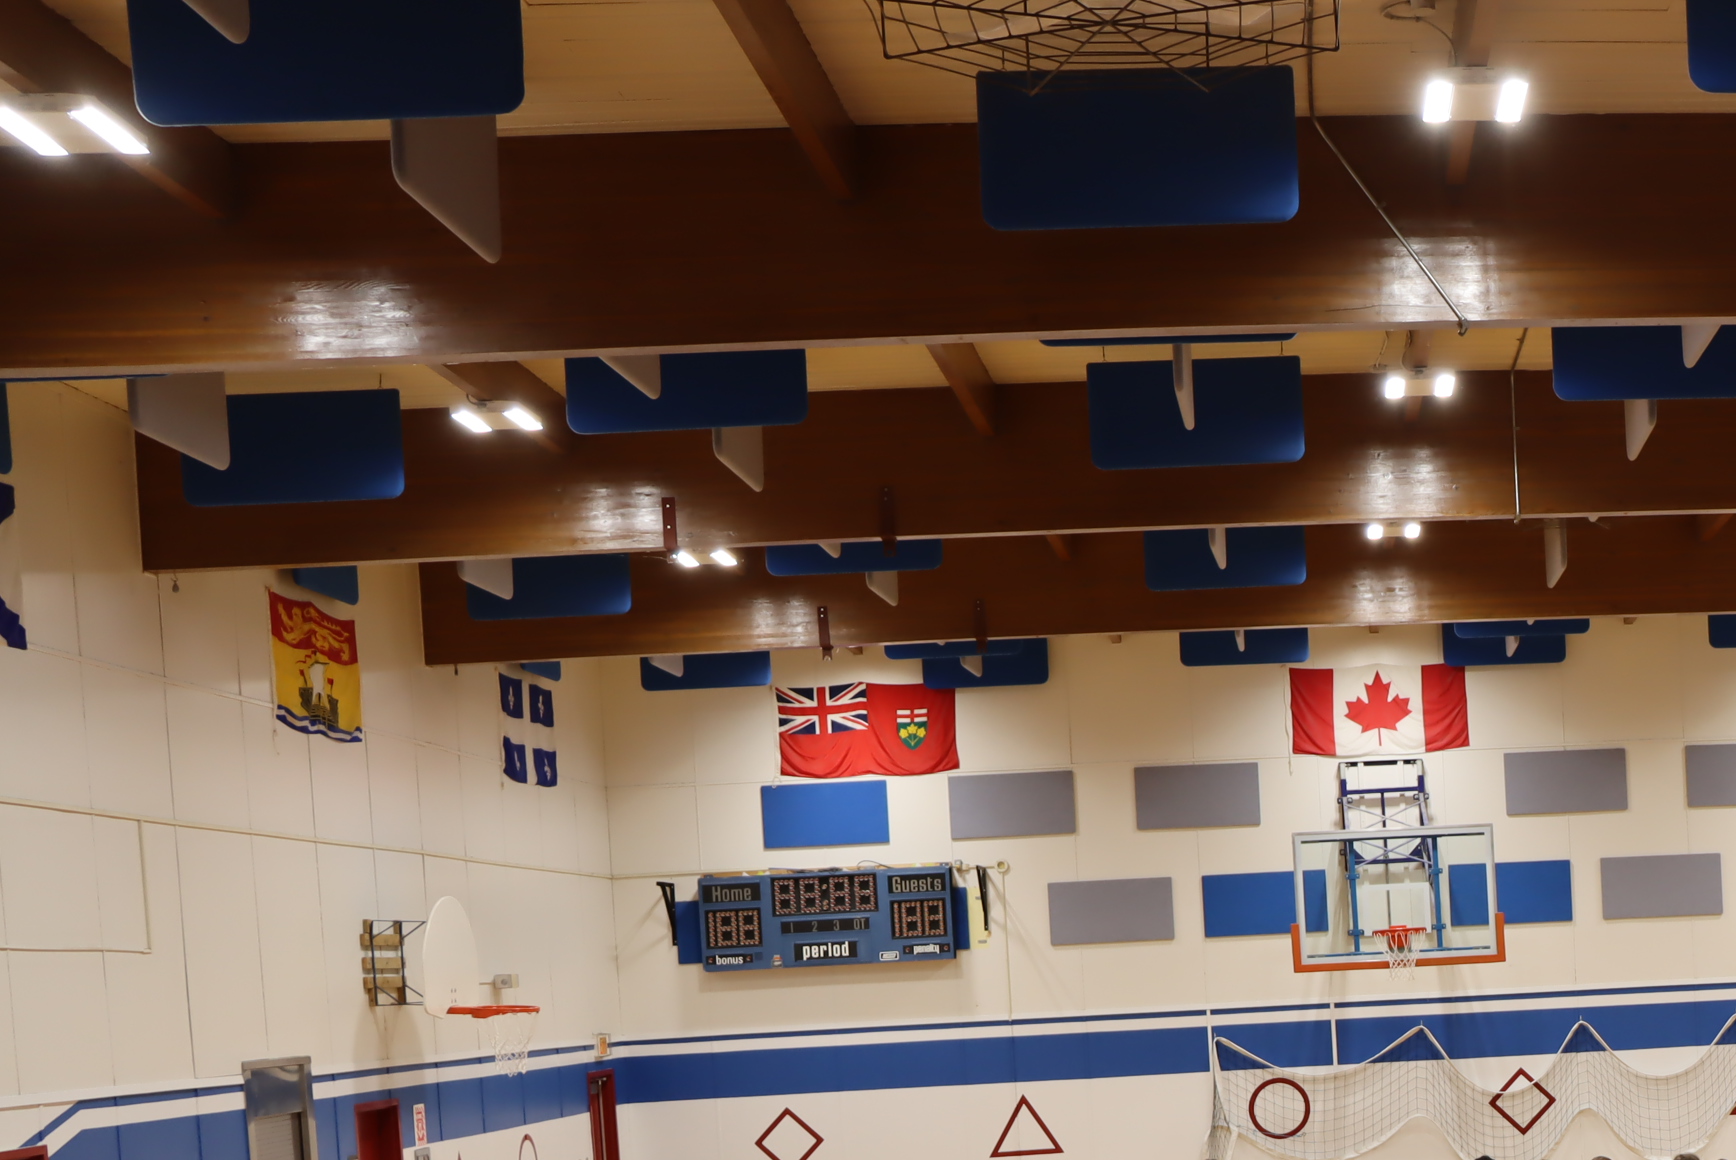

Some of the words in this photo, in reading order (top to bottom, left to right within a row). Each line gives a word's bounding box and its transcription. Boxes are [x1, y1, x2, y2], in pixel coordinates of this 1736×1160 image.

[892, 876, 942, 893] Guests
[712, 886, 752, 902] Home
[812, 920, 819, 932] 2
[833, 920, 840, 932] 3
[853, 917, 866, 930] OT
[802, 941, 850, 960] period
[912, 943, 941, 956] penalty
[715, 954, 744, 966] bonus
